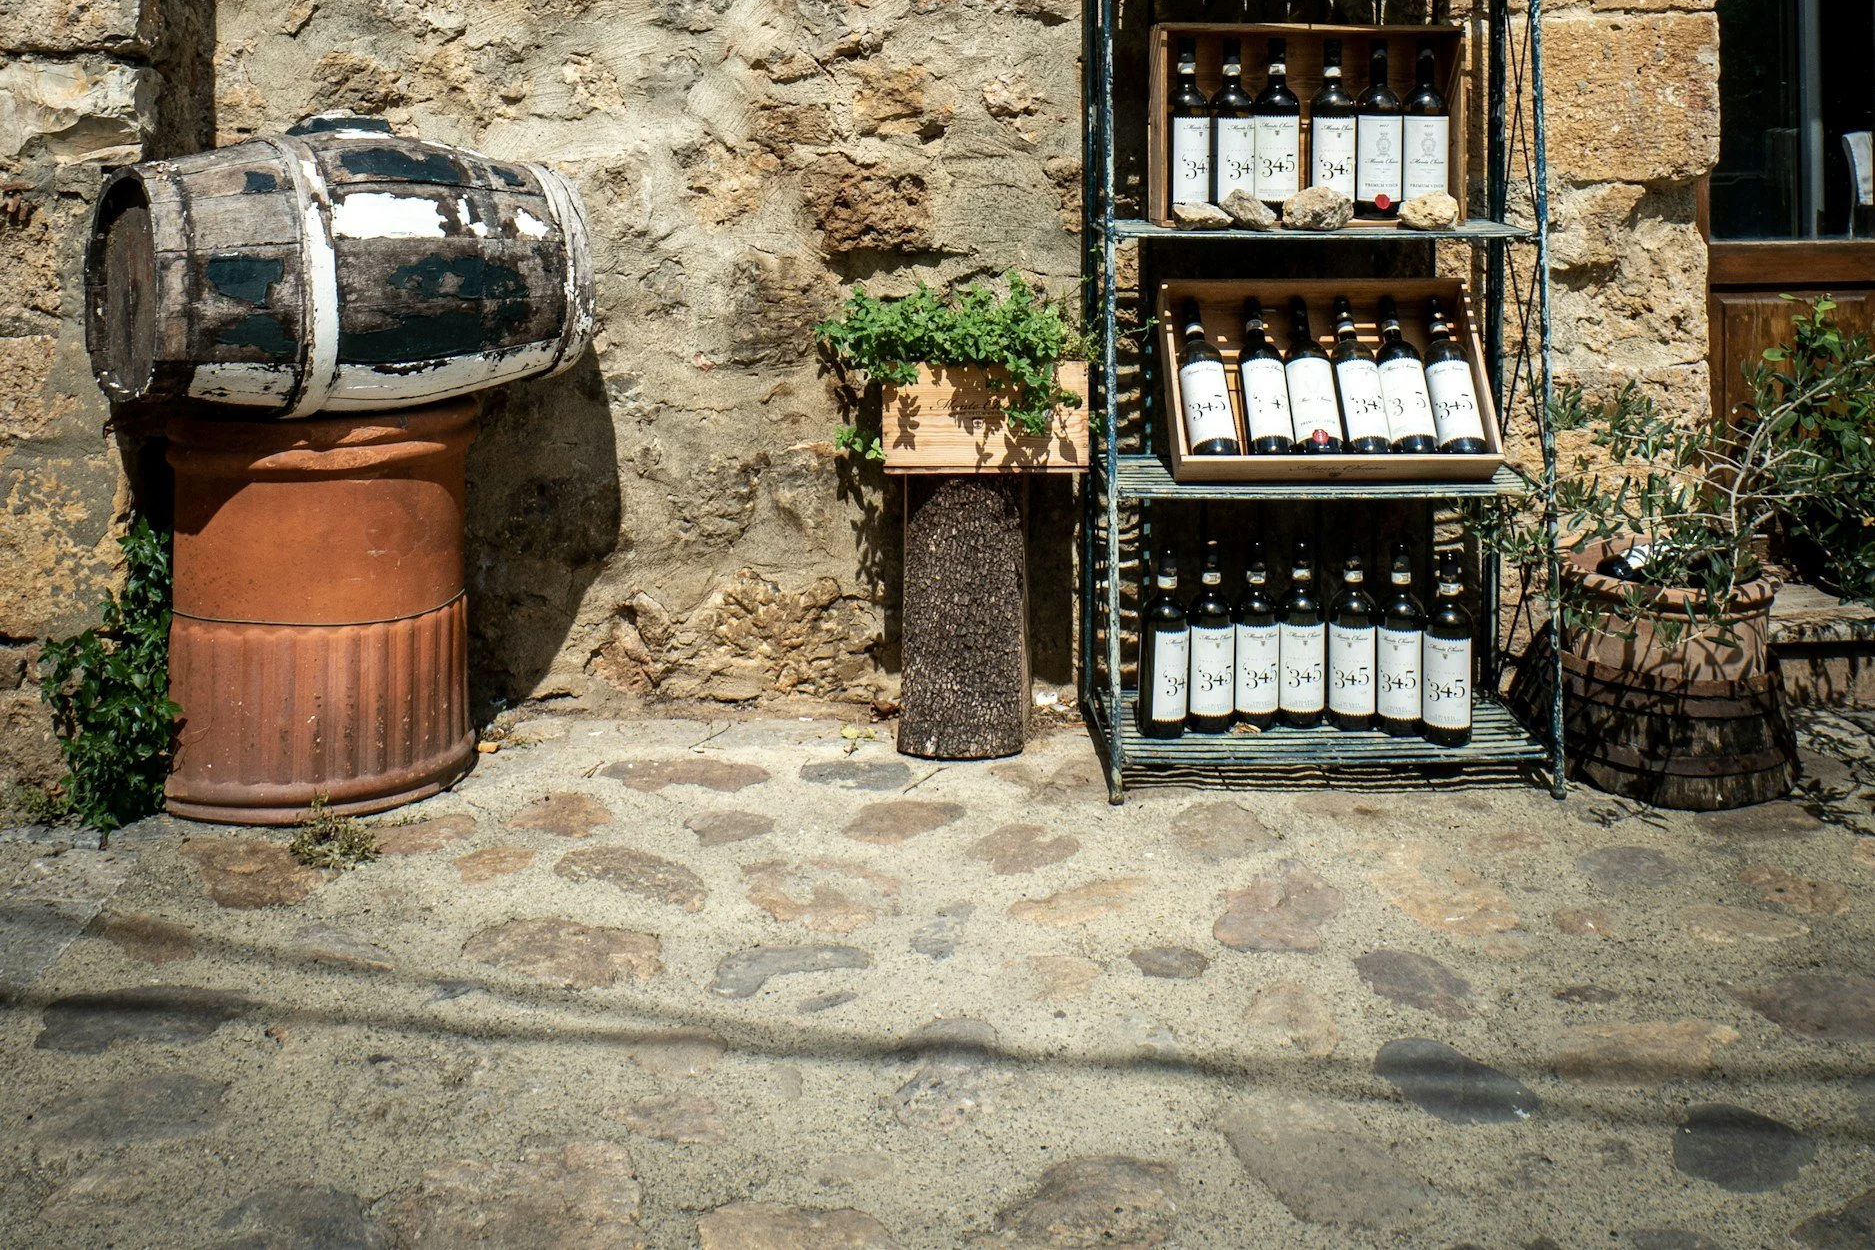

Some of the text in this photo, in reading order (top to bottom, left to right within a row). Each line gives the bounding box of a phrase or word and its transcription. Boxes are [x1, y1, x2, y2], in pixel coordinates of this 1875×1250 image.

[1259, 152, 1296, 178] '345
[1163, 669, 1186, 697] '34
[1198, 665, 1233, 692] '345
[1243, 662, 1278, 690] '345
[1285, 661, 1323, 689] '345
[1333, 663, 1370, 690] '345
[1380, 668, 1417, 693] '345
[1426, 674, 1466, 702] '345
